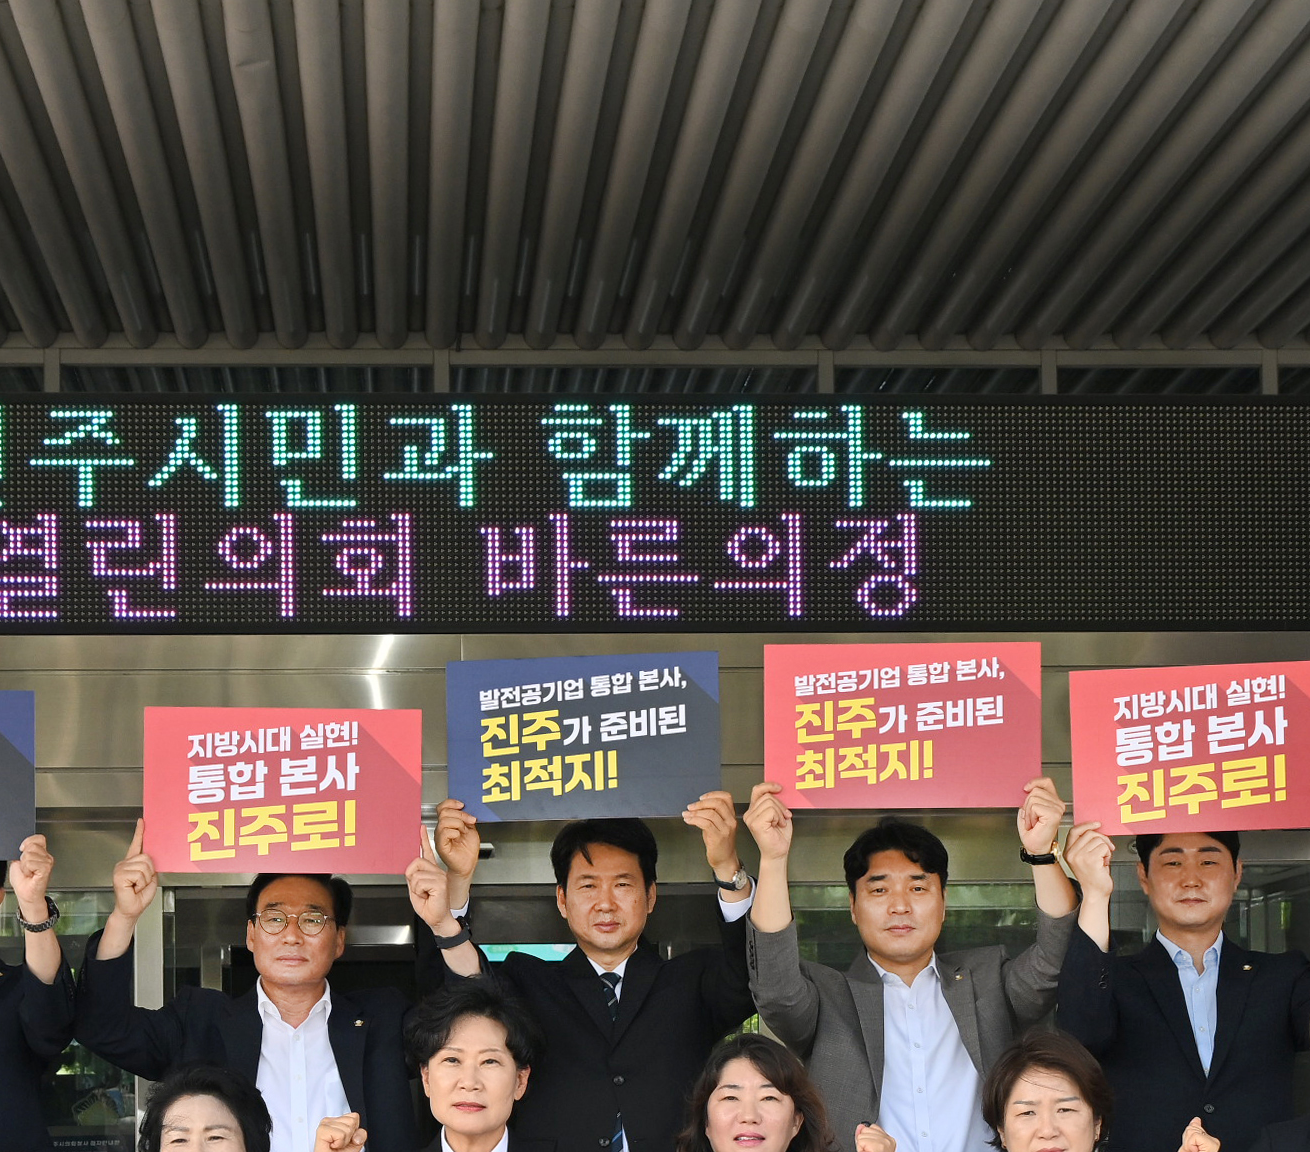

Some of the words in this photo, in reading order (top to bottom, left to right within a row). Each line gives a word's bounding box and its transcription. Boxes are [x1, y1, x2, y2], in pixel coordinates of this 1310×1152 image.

[540, 404, 992, 509] 함께하는
[479, 513, 918, 618] 바른의정
[480, 678, 583, 711] 발전공기업
[591, 672, 633, 697] 통합
[639, 666, 686, 691] 본사,
[795, 666, 900, 696] 발전공기업
[907, 662, 950, 685] 통합
[956, 657, 1004, 681] 본사,
[1114, 683, 1217, 721] 지방시대
[1226, 675, 1285, 706] 실현!
[188, 726, 290, 758] 지방시대
[300, 721, 358, 750] 실현!
[481, 710, 591, 757] 진주가
[600, 704, 686, 742] 준비된
[795, 698, 907, 743] 진주가
[916, 695, 1003, 731] 준비된
[1116, 719, 1195, 766] 통합
[1208, 706, 1288, 754] 본사
[188, 760, 268, 804] 통합
[280, 752, 359, 796] 본사
[482, 748, 617, 803] 최적지!
[796, 739, 933, 789] 최적지!
[1116, 755, 1286, 824] 진주로!
[187, 800, 356, 861] 진주로!
